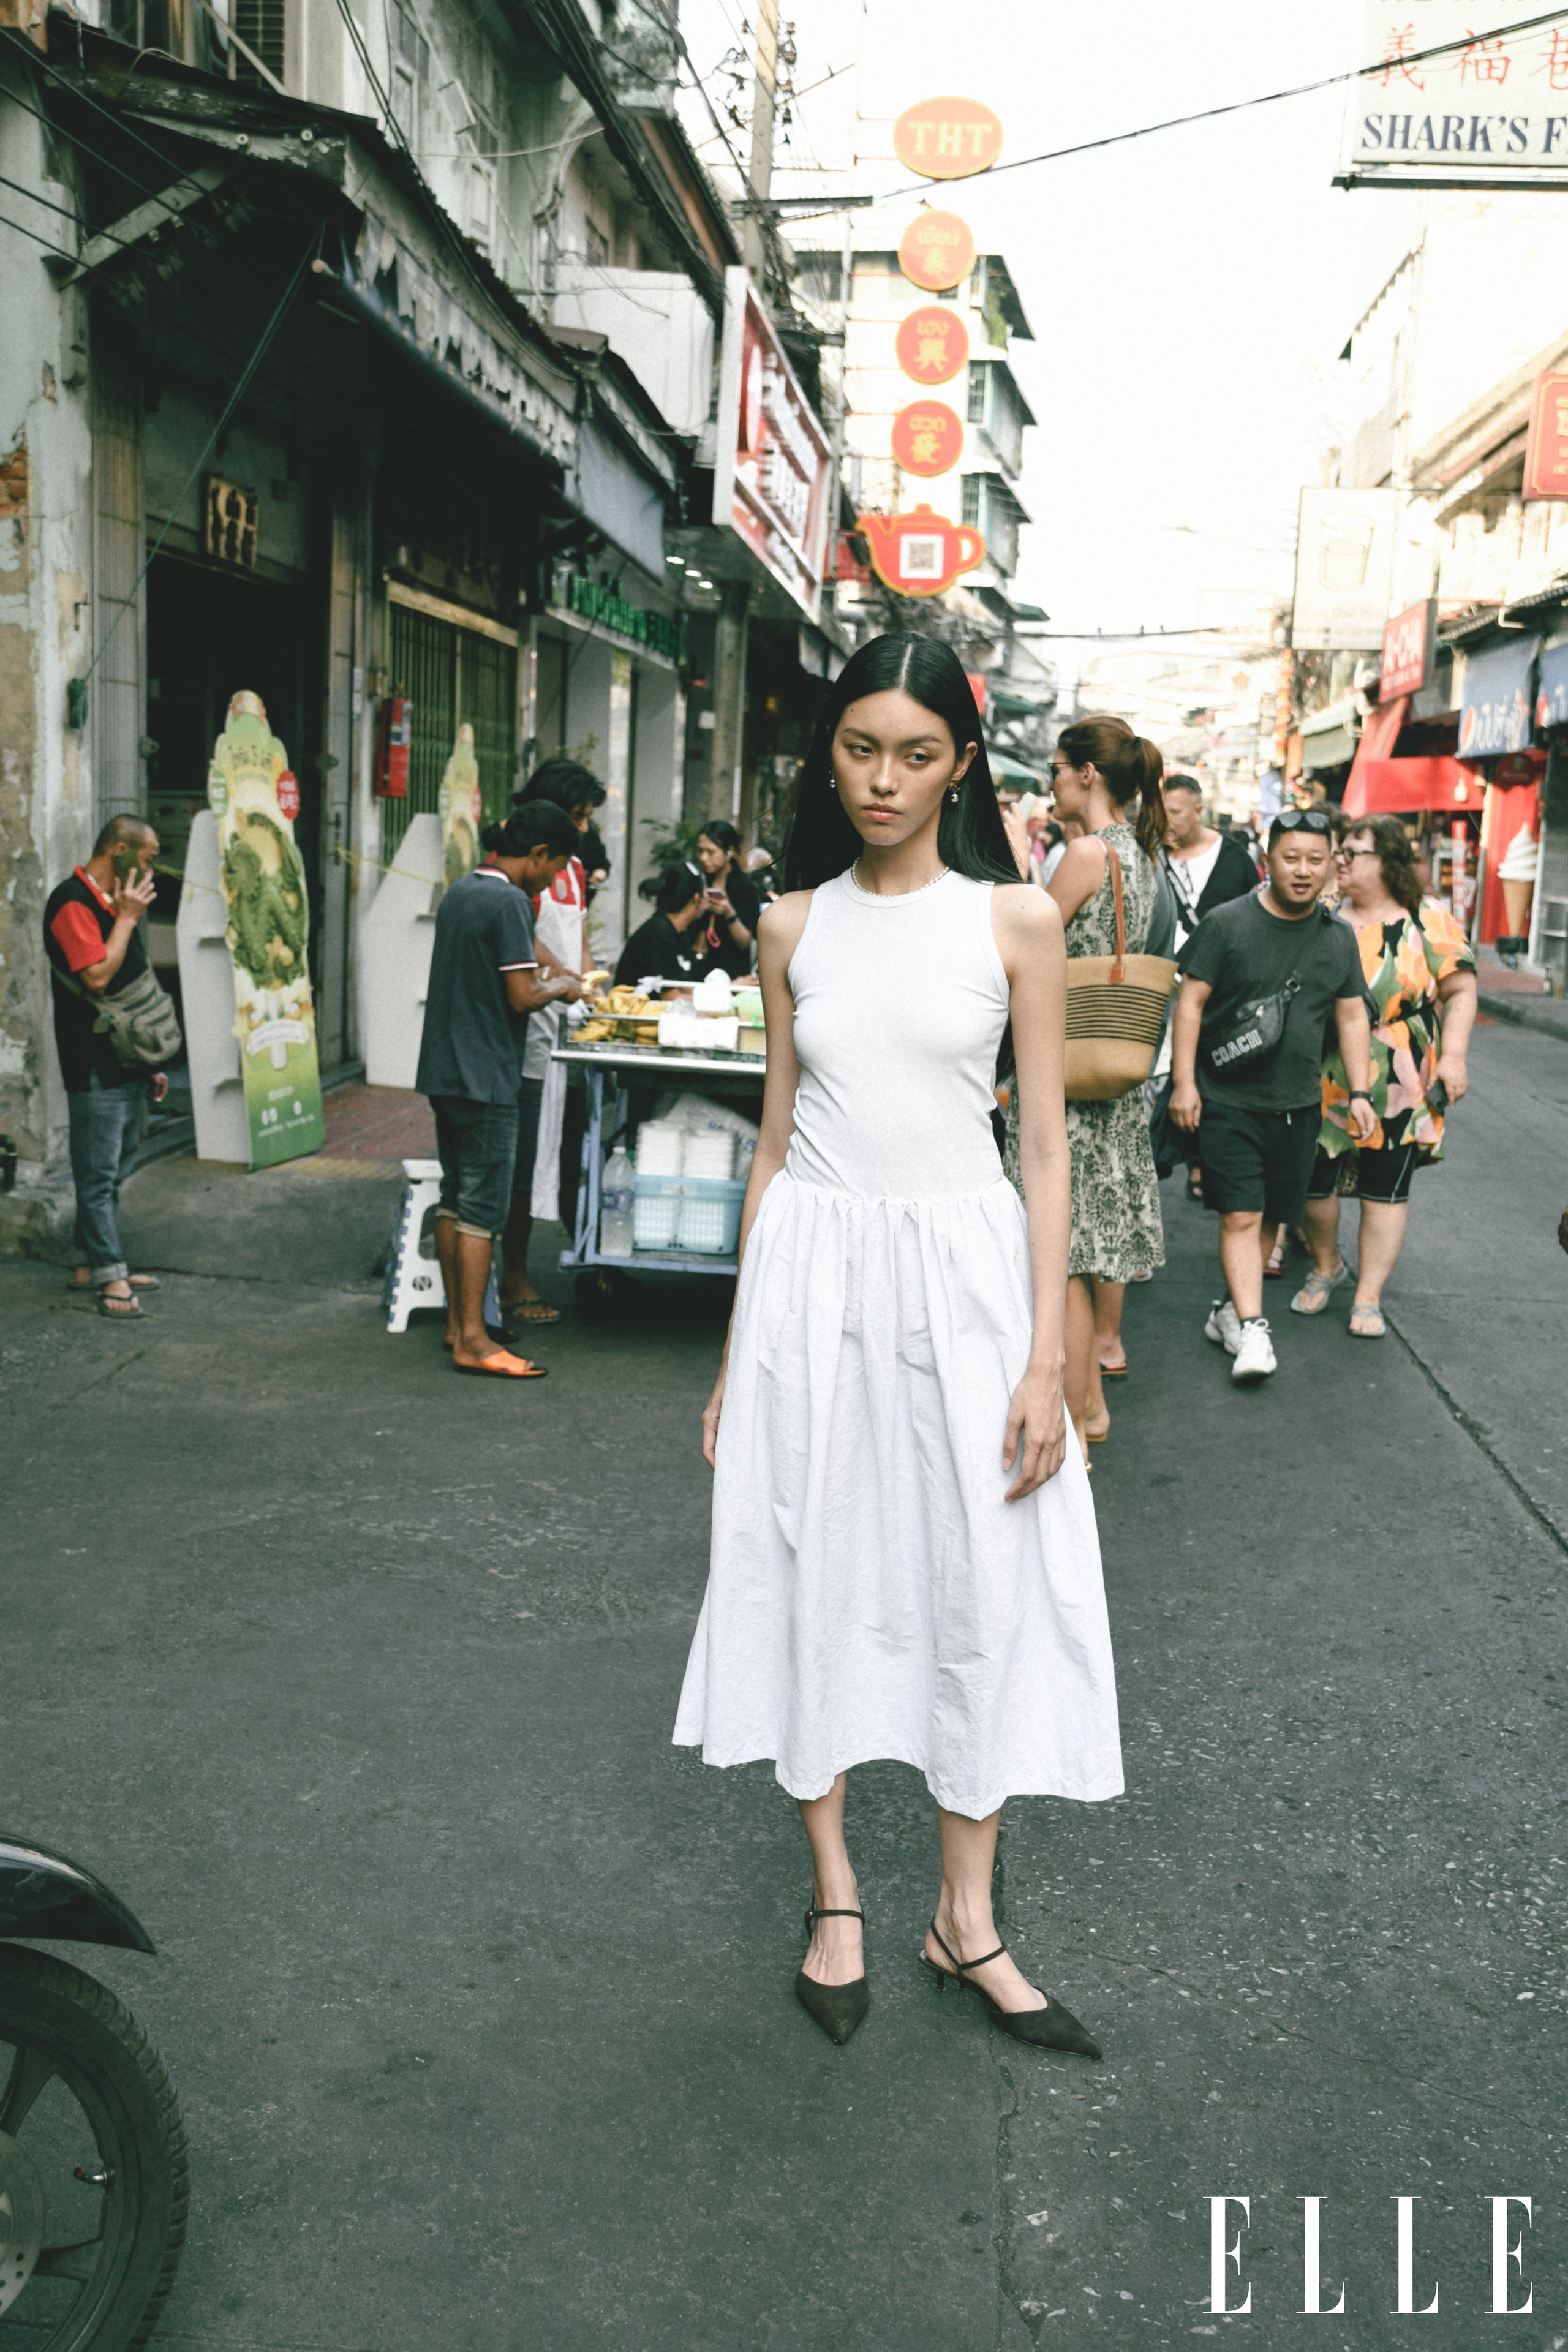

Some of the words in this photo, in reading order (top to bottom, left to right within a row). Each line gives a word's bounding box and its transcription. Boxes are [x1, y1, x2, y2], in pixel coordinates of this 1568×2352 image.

[907, 121, 992, 157] THT
[913, 337, 949, 372] 興
[1211, 1028, 1263, 1067] COACH
